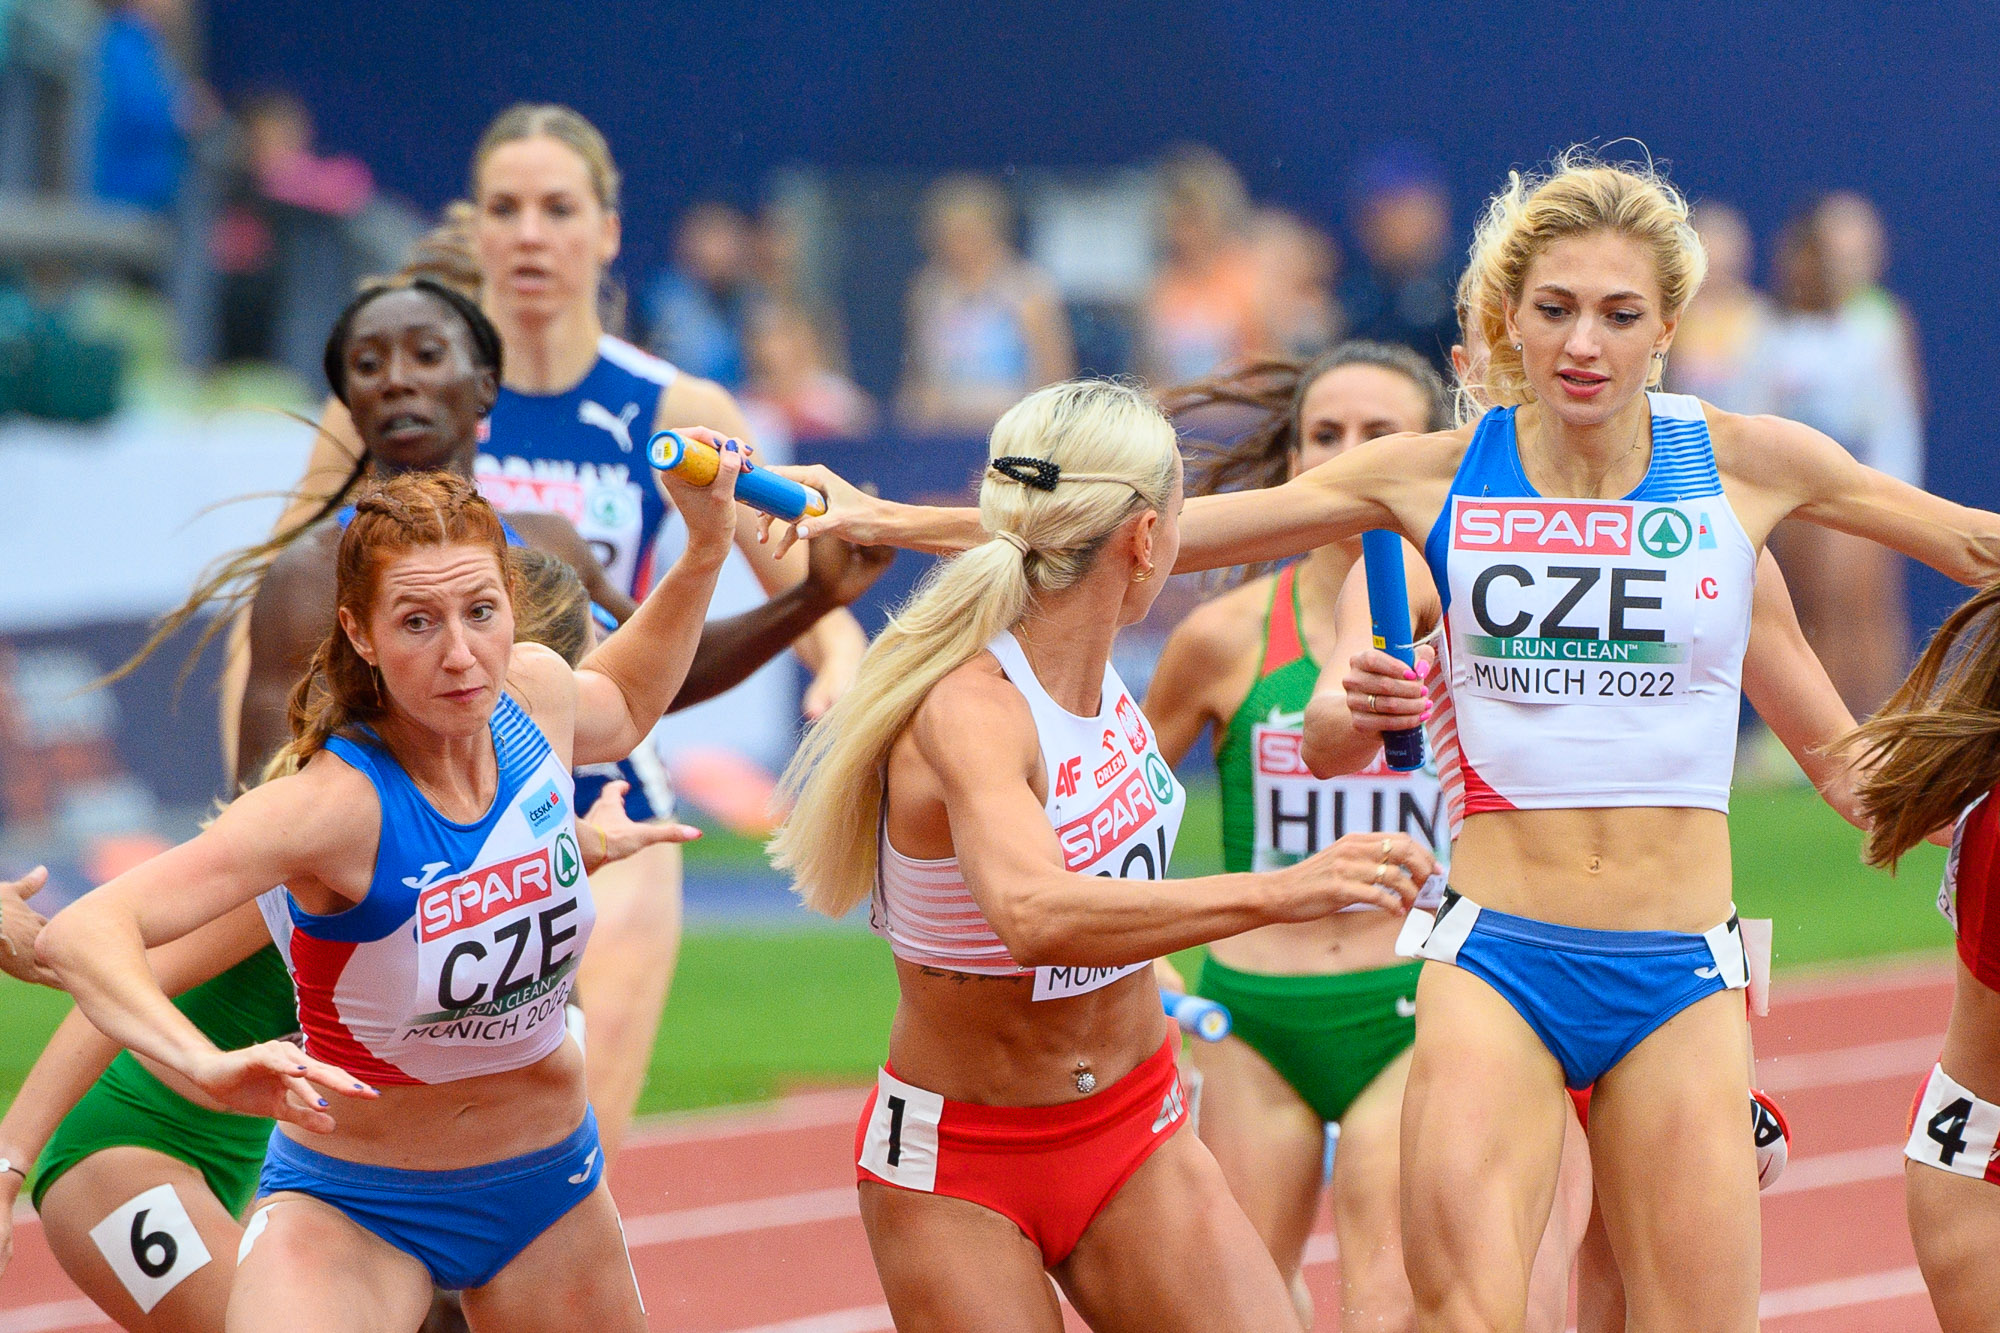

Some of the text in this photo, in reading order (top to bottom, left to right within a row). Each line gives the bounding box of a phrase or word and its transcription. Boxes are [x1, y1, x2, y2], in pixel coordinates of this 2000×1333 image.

[1460, 508, 1628, 549] SPAR
[1471, 563, 1667, 642] CZE
[1474, 662, 1675, 697] MUNICH 2022
[1501, 639, 1506, 656] I
[1512, 640, 1556, 658] RUN
[1096, 752, 1125, 788] ORLEN
[1060, 776, 1152, 867] SPAR
[1271, 788, 1442, 854] HUN
[425, 857, 548, 935] SPAR
[438, 896, 578, 1011] CZE
[401, 980, 567, 1041] MUNICH 2022
[464, 1000, 503, 1017] RUN
[887, 1094, 906, 1168] 1
[1927, 1097, 1974, 1167] 4
[130, 1208, 179, 1279] 6
